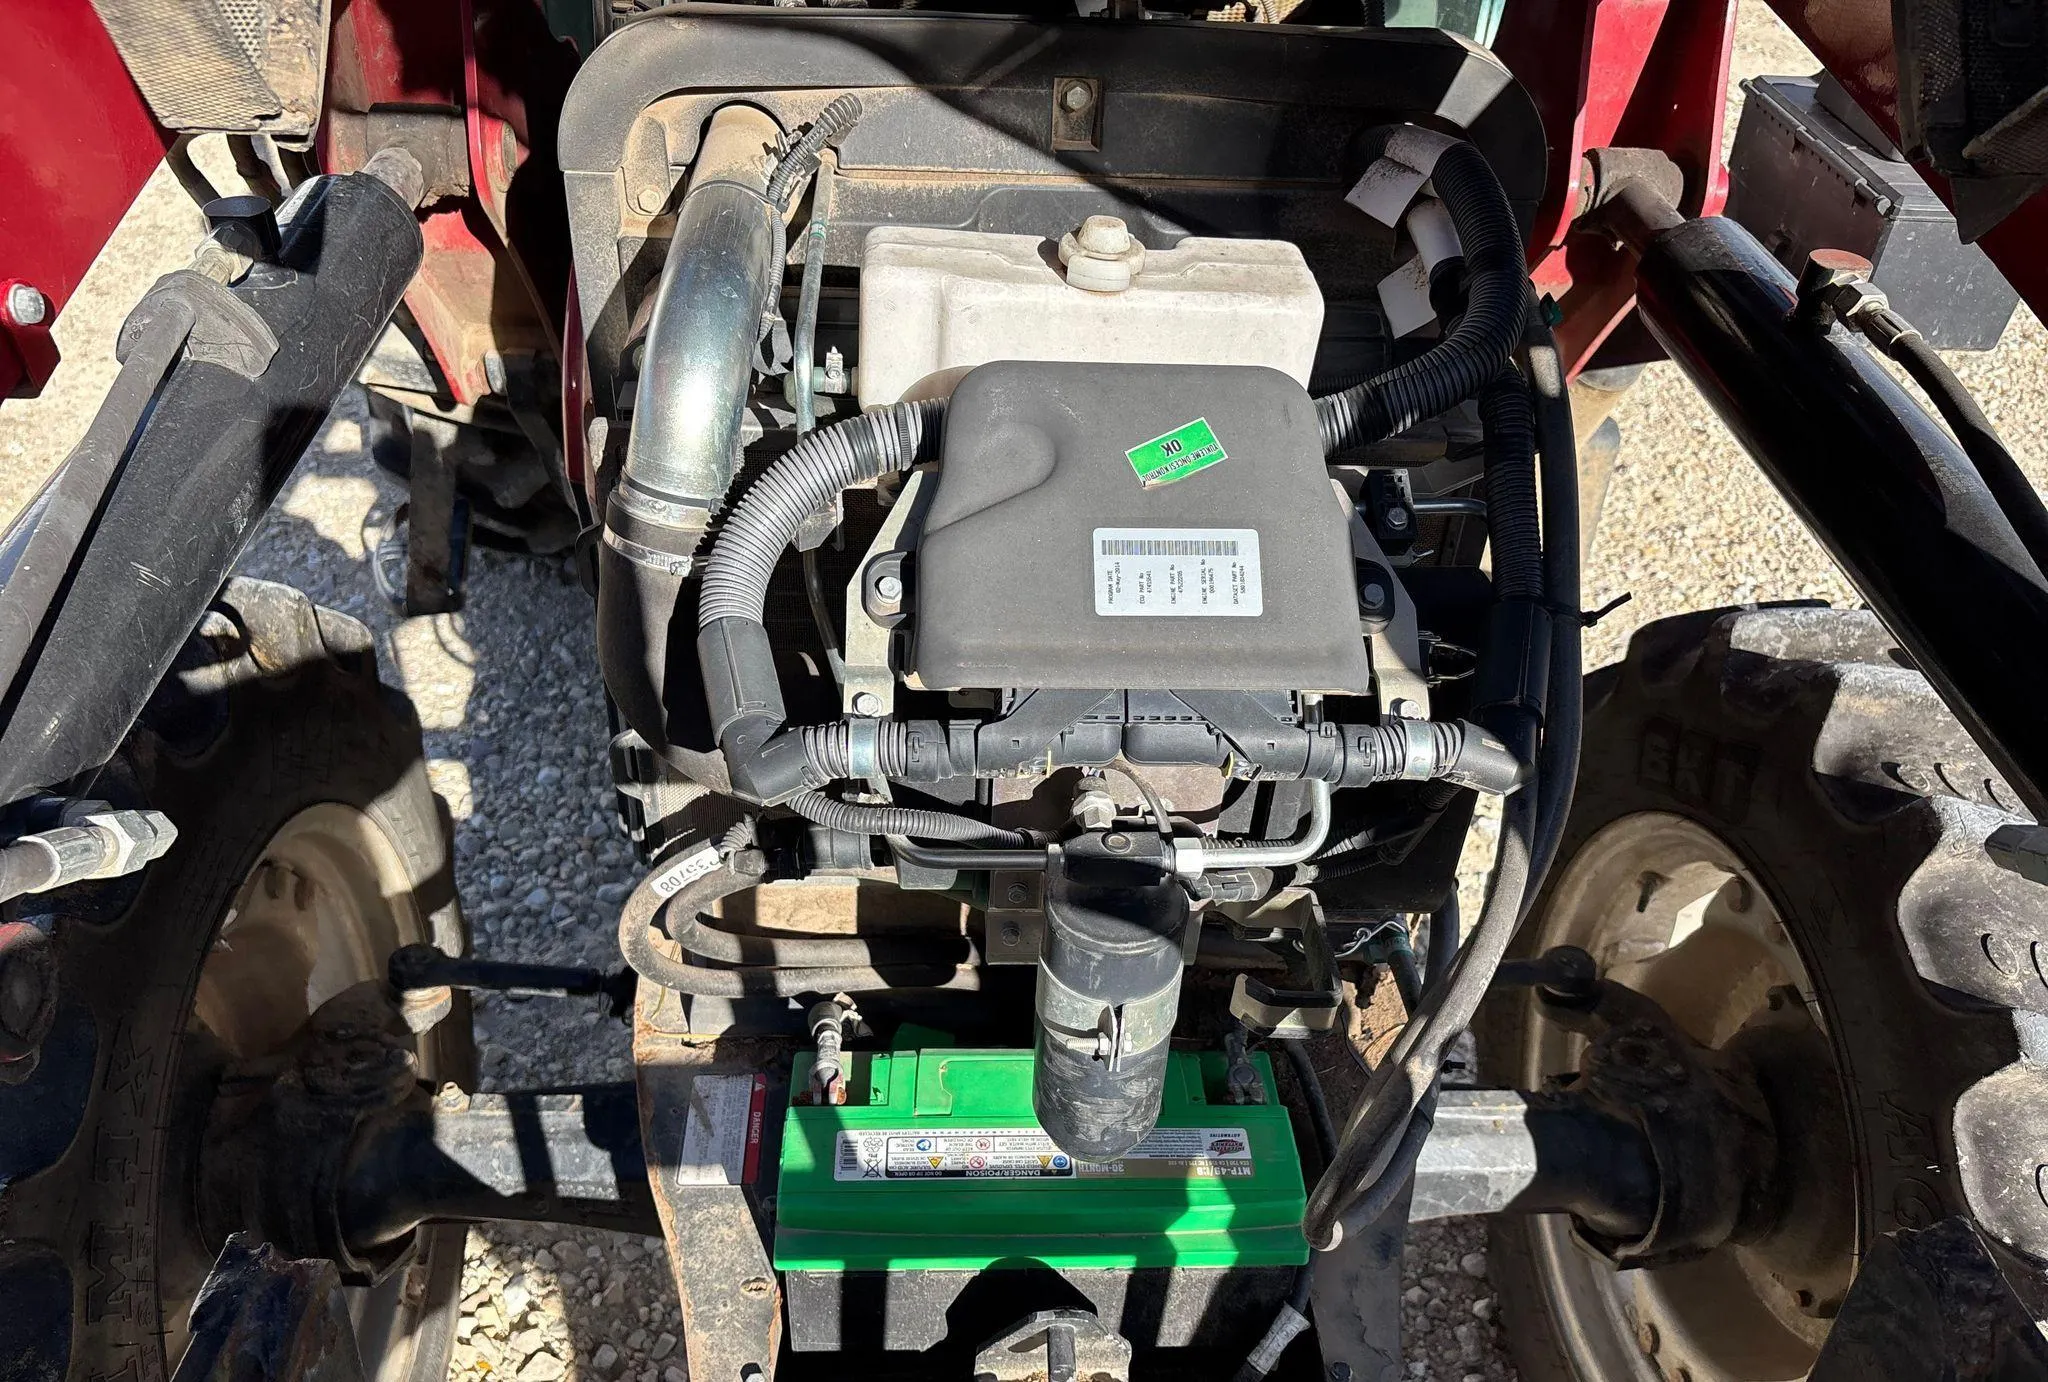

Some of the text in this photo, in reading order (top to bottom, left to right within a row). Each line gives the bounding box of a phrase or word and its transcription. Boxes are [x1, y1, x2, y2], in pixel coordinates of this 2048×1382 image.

[1161, 439, 1182, 457] OK
[750, 1112, 761, 1144] DANGER
[1079, 1164, 1125, 1173] 30-MONTH
